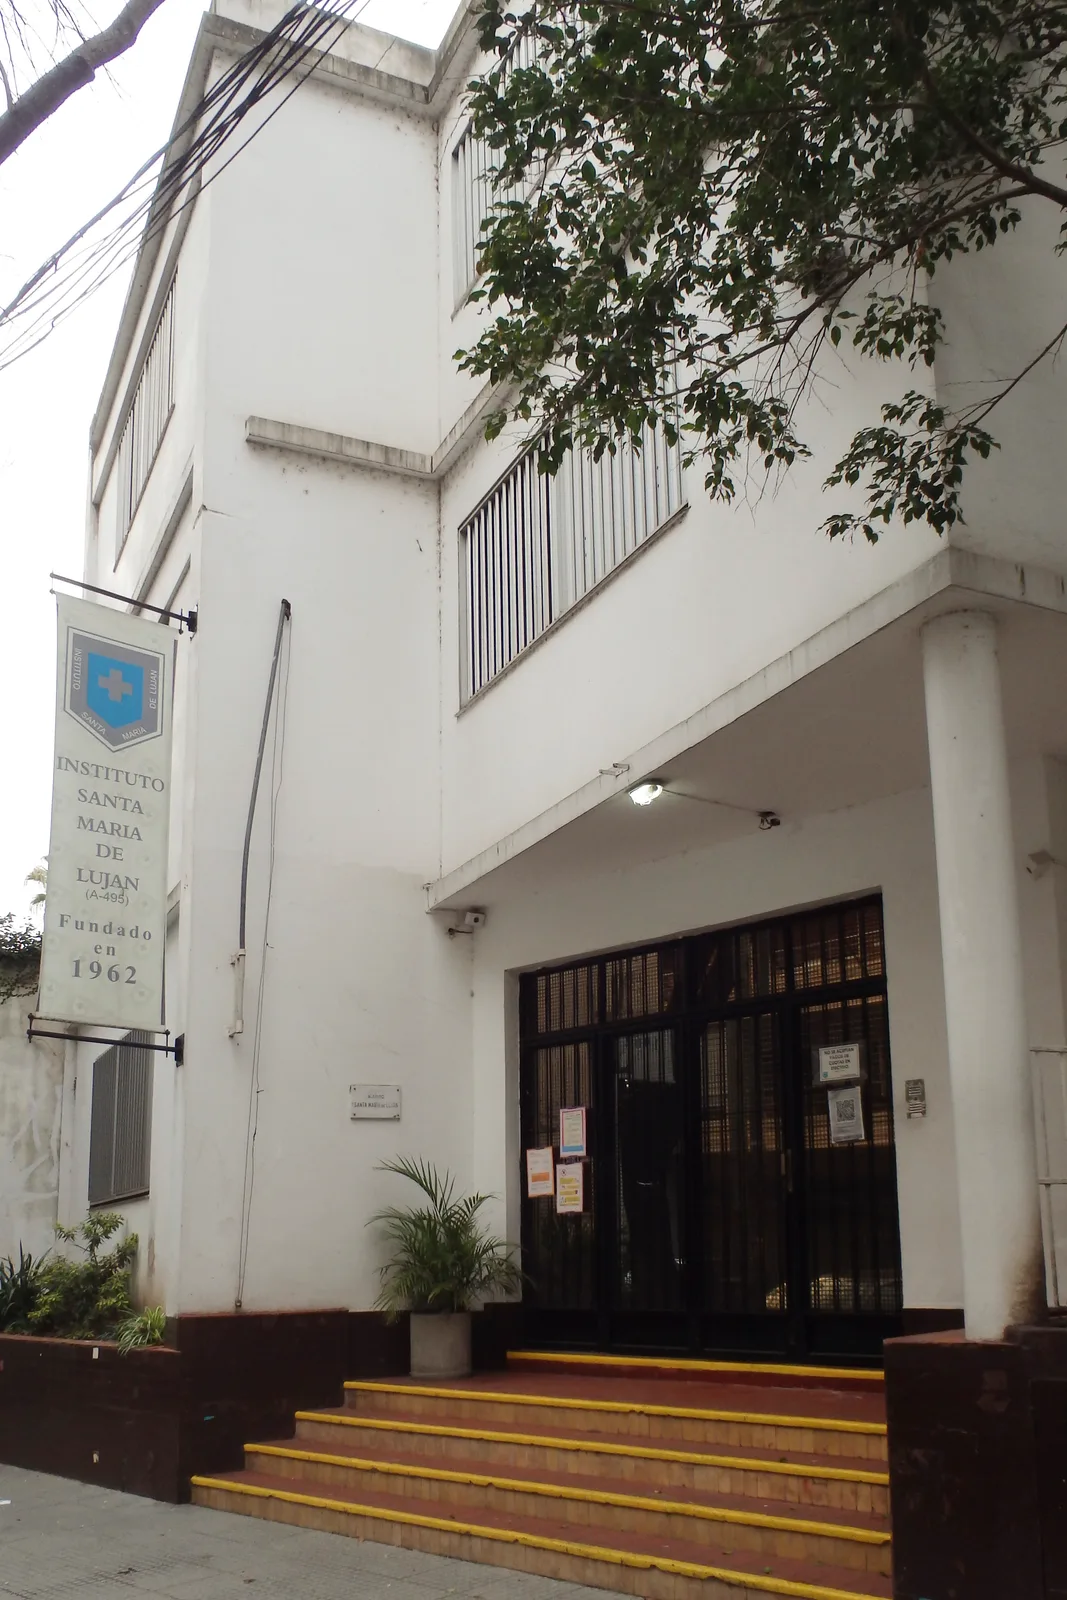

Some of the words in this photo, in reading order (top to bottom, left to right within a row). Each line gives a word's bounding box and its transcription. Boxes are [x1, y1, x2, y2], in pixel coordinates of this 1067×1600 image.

[72, 647, 82, 690] INSTITUTO
[149, 669, 157, 695] LUJAN
[149, 698, 157, 709] DE
[81, 711, 106, 735] SANTA
[121, 726, 147, 741] MARIA
[57, 756, 165, 792] INSTITUTO
[77, 788, 144, 815] SANTA
[77, 815, 143, 841] MARIA
[96, 843, 124, 861] DE
[76, 868, 139, 891] LUJAN
[85, 889, 129, 907] (A-495)
[59, 913, 152, 941] Fundado
[94, 944, 116, 956] en
[71, 959, 137, 985] 1962
